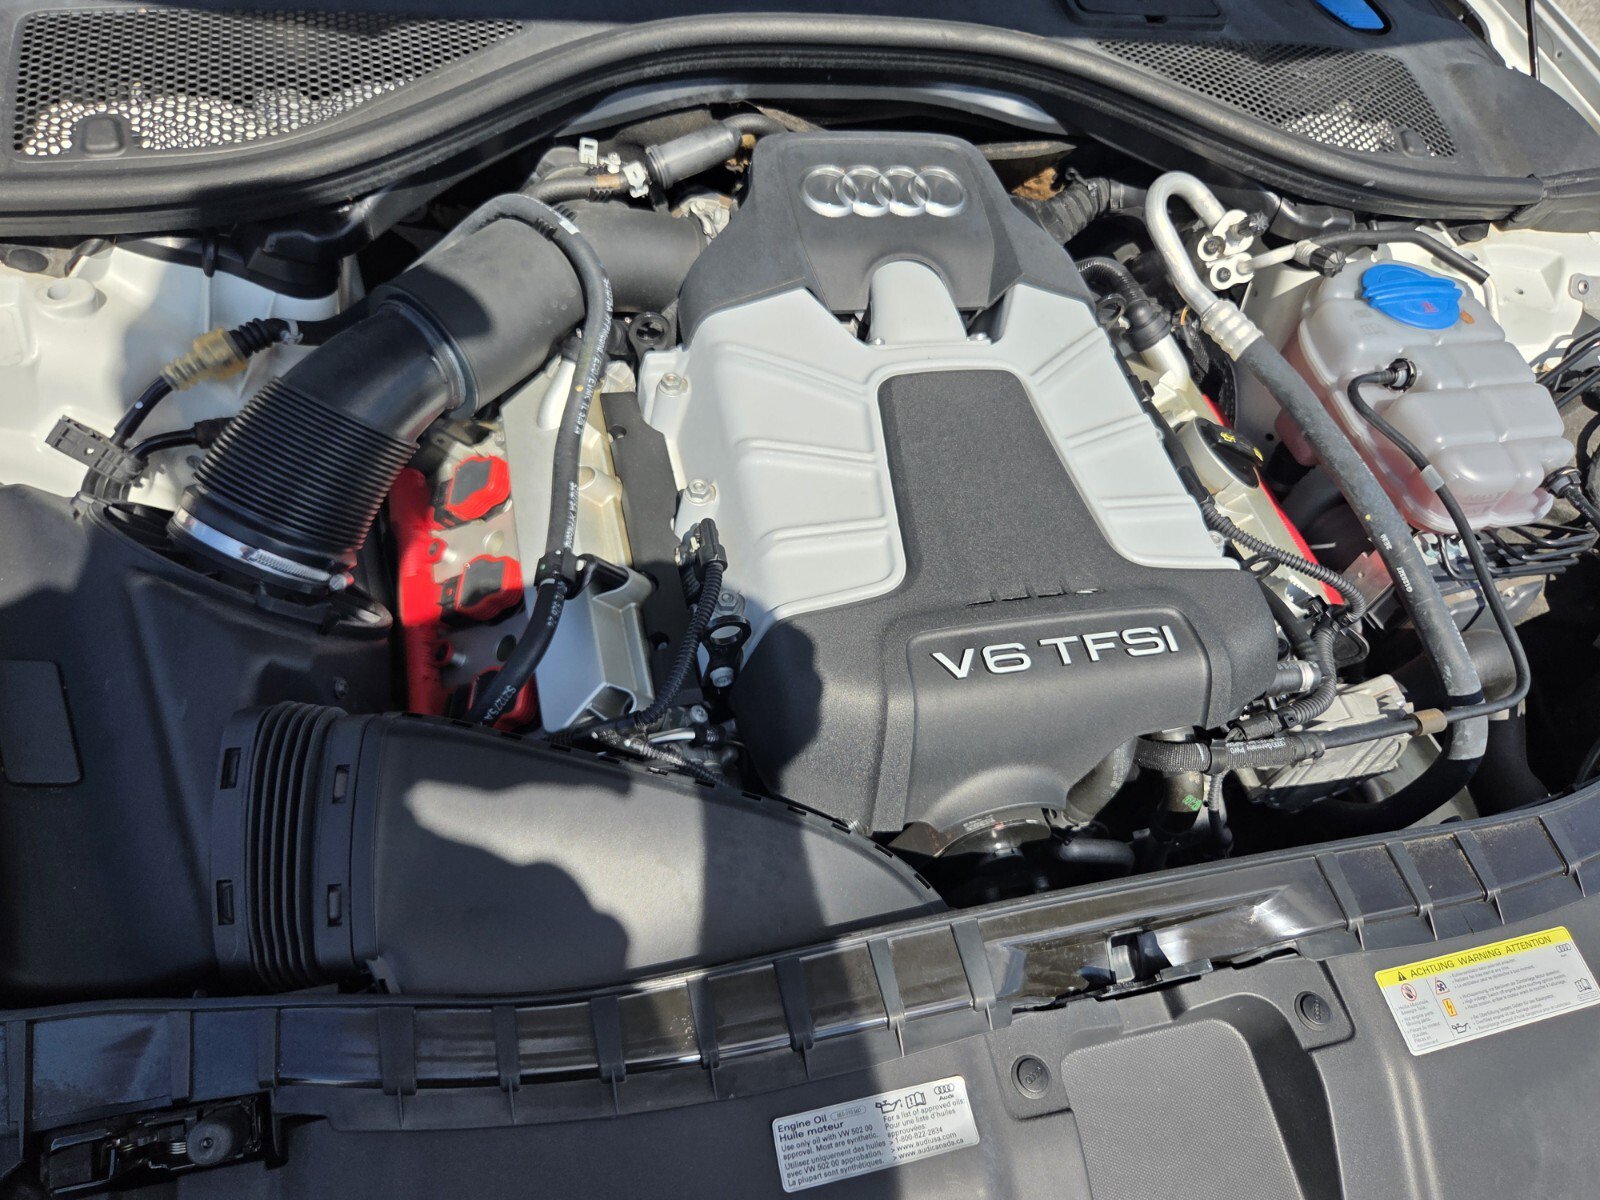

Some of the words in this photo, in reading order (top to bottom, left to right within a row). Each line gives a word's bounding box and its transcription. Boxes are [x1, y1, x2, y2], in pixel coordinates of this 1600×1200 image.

[931, 642, 1032, 679] V6
[1038, 625, 1179, 666] TFSI
[1411, 960, 1454, 977] ACHTUNG
[1457, 948, 1501, 965] WARNING
[1506, 936, 1551, 953] ATTENTION
[912, 1108, 919, 1116] of
[921, 1101, 951, 1114] approved
[952, 1098, 965, 1106] oils:
[778, 1120, 810, 1132] Engine
[814, 1114, 827, 1124] Oil
[779, 1131, 804, 1142] Huile
[807, 1122, 843, 1135] moteur
[884, 1122, 900, 1131] Pour
[915, 1115, 929, 1123] liste
[930, 1109, 956, 1119] d'huiles
[887, 1124, 926, 1139] approuvées:
[781, 1144, 794, 1152] Use
[796, 1140, 810, 1148] only
[812, 1137, 820, 1145] oil
[822, 1133, 837, 1142] with
[838, 1129, 849, 1138] VW
[851, 1126, 863, 1135] 502
[865, 1124, 873, 1132] 00
[783, 1147, 814, 1160] approval.
[816, 1143, 833, 1152] Most
[847, 1132, 878, 1145] synthetic.
[897, 1132, 956, 1151] www.audiusa.com
[898, 1139, 963, 1159] www.audicanada.ca
[785, 1159, 810, 1170] Utilisez
[811, 1149, 851, 1164] uniquement
[866, 1141, 886, 1150] huiles
[787, 1170, 802, 1179] avec
[804, 1165, 815, 1173] VW
[817, 1161, 829, 1171] 502
[831, 1159, 839, 1167] 00
[841, 1150, 883, 1165] approbation.
[798, 1173, 822, 1185] plupart
[824, 1169, 839, 1178] sont
[840, 1159, 884, 1174] synthétiques.
